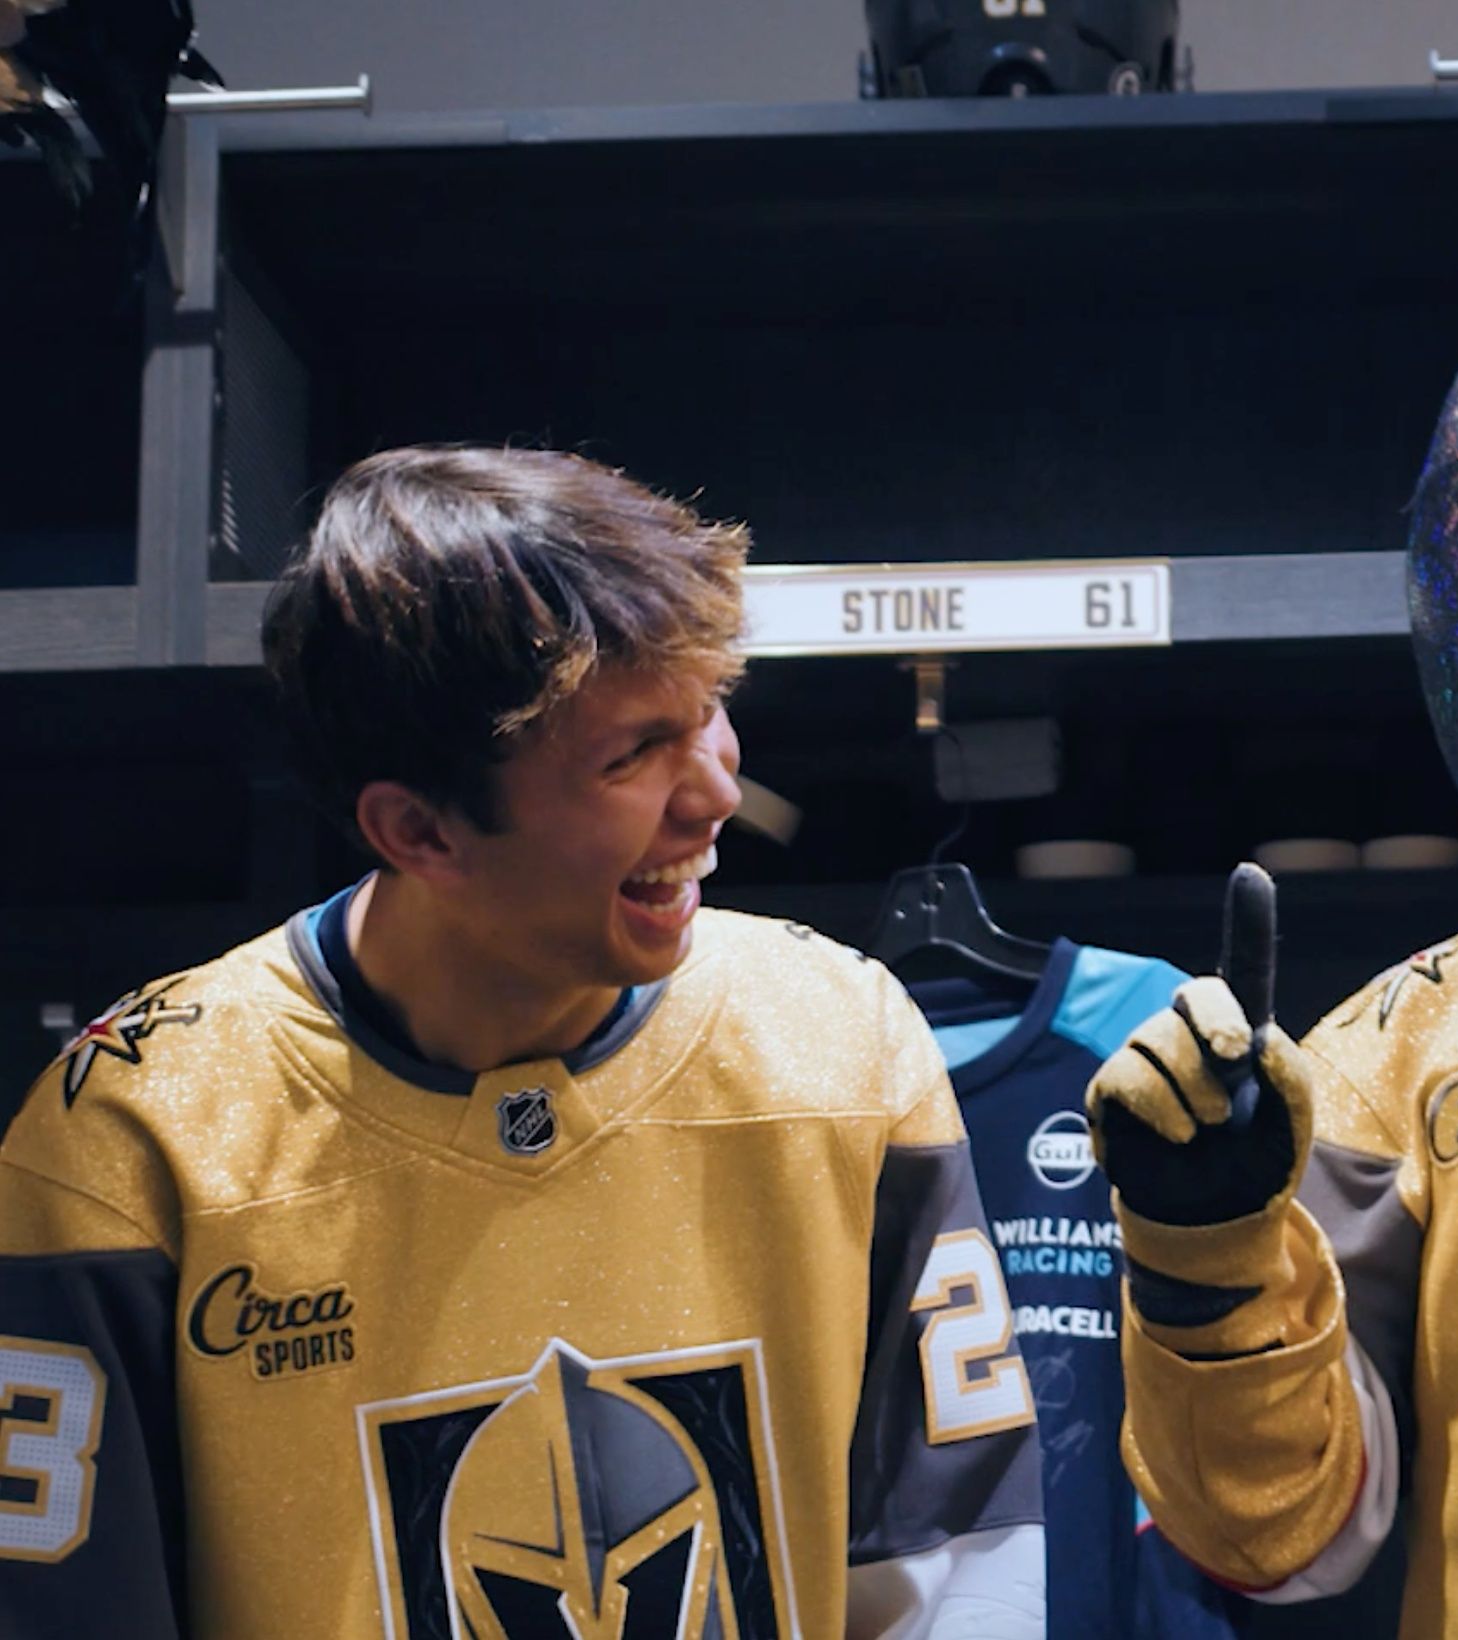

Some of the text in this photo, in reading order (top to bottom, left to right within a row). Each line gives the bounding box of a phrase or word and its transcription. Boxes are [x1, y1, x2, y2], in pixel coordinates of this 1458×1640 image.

[842, 580, 1136, 633] STONE 61
[1033, 1139, 1095, 1162] Gul
[1007, 1247, 1113, 1277] RACING
[189, 1265, 354, 1357] Circa
[909, 1227, 1037, 1445] 2
[255, 1328, 355, 1377] SPORTS
[0, 1334, 108, 1564] 3
